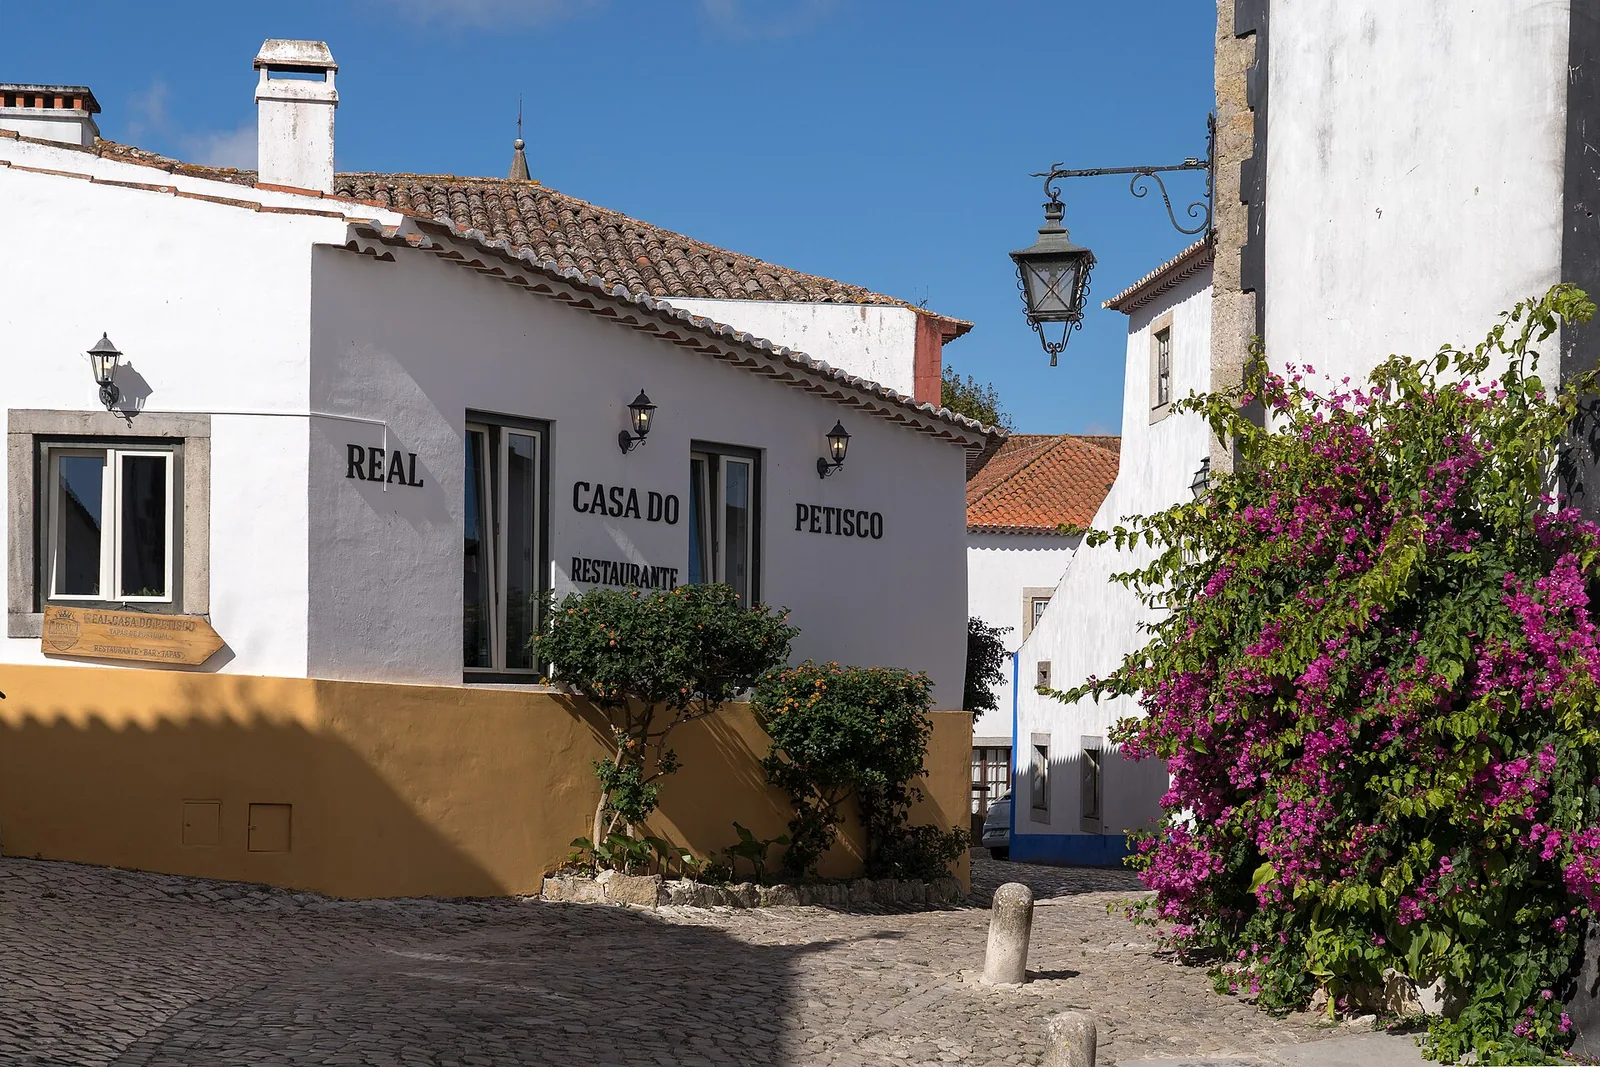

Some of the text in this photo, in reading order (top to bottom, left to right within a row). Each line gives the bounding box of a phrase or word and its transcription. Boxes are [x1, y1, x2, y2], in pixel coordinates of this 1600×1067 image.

[345, 443, 424, 487] REAL
[572, 481, 679, 524] CASA DO
[794, 502, 884, 540] PETISCO
[571, 557, 678, 590] RESTAURANTE
[84, 613, 196, 631] REAL CASA DO PETISCO
[109, 628, 128, 636] TAPAS
[94, 644, 181, 659] RESTAURANTE BAR TAPAS
